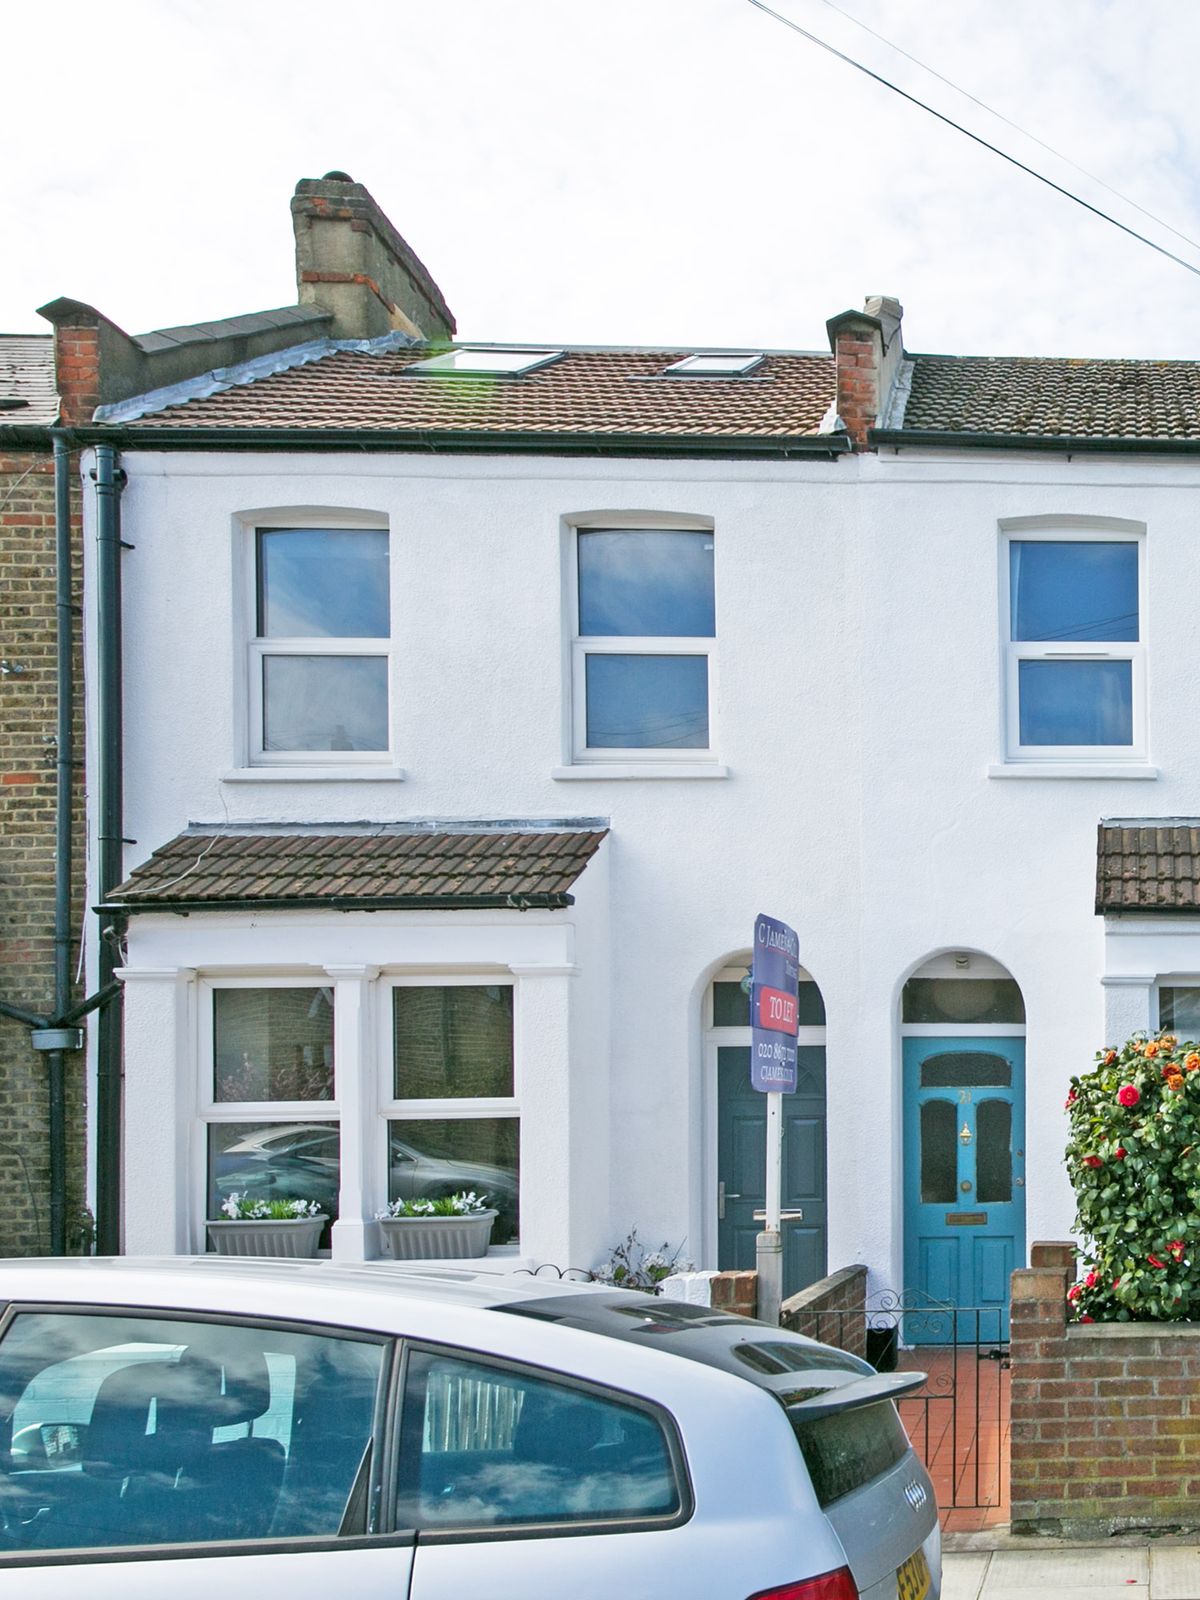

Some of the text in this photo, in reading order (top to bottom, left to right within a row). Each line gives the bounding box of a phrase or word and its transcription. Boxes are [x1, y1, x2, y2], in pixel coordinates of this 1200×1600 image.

[759, 923, 766, 943] C
[769, 996, 795, 1023] TO LET
[758, 1043, 773, 1058] 020
